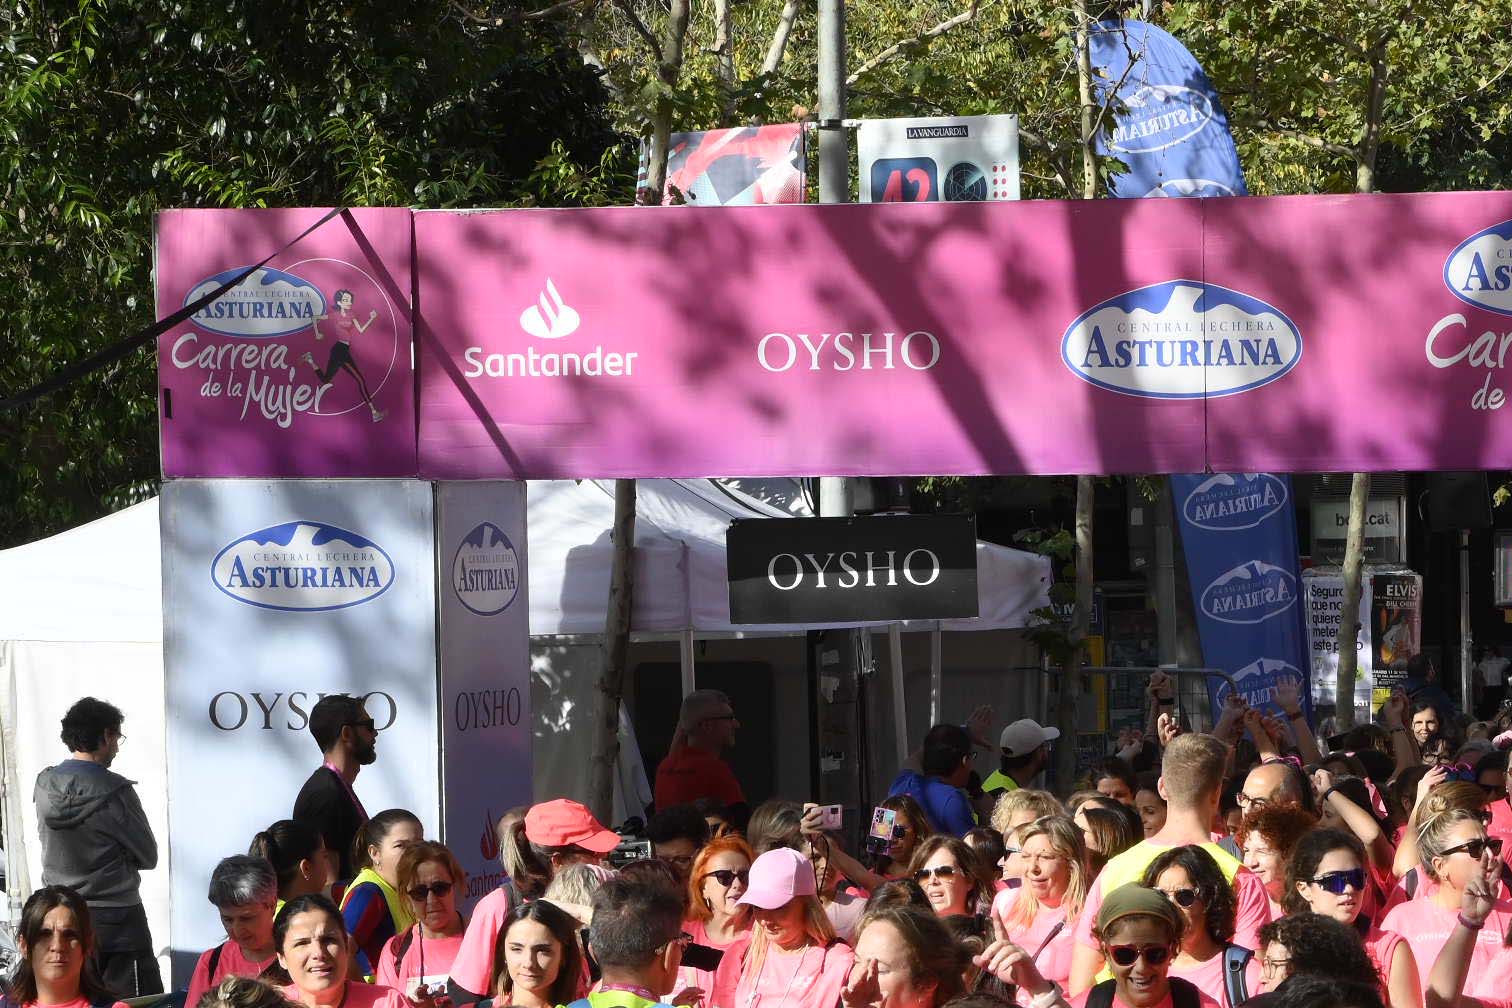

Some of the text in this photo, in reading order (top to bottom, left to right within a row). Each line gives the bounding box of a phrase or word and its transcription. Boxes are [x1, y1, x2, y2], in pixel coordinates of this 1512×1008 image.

[194, 292, 314, 320] ASTURIANA
[1117, 320, 1278, 335] CENTRAL LECHERA
[171, 332, 289, 370] Carrera
[464, 347, 639, 378] Santander
[757, 331, 941, 372] OYSHO
[1081, 326, 1284, 369] ASTURIANA
[201, 367, 334, 429] de la Mujer
[1471, 373, 1506, 411] de
[227, 554, 382, 588] ASTURIANA
[253, 552, 376, 562] CENTRAL LECHERA
[458, 557, 516, 593] ASTURIANA
[767, 548, 941, 591] OYSHO
[1386, 584, 1417, 597] ELVIS
[208, 691, 398, 731] OYSO
[455, 687, 521, 732] OYSHO
